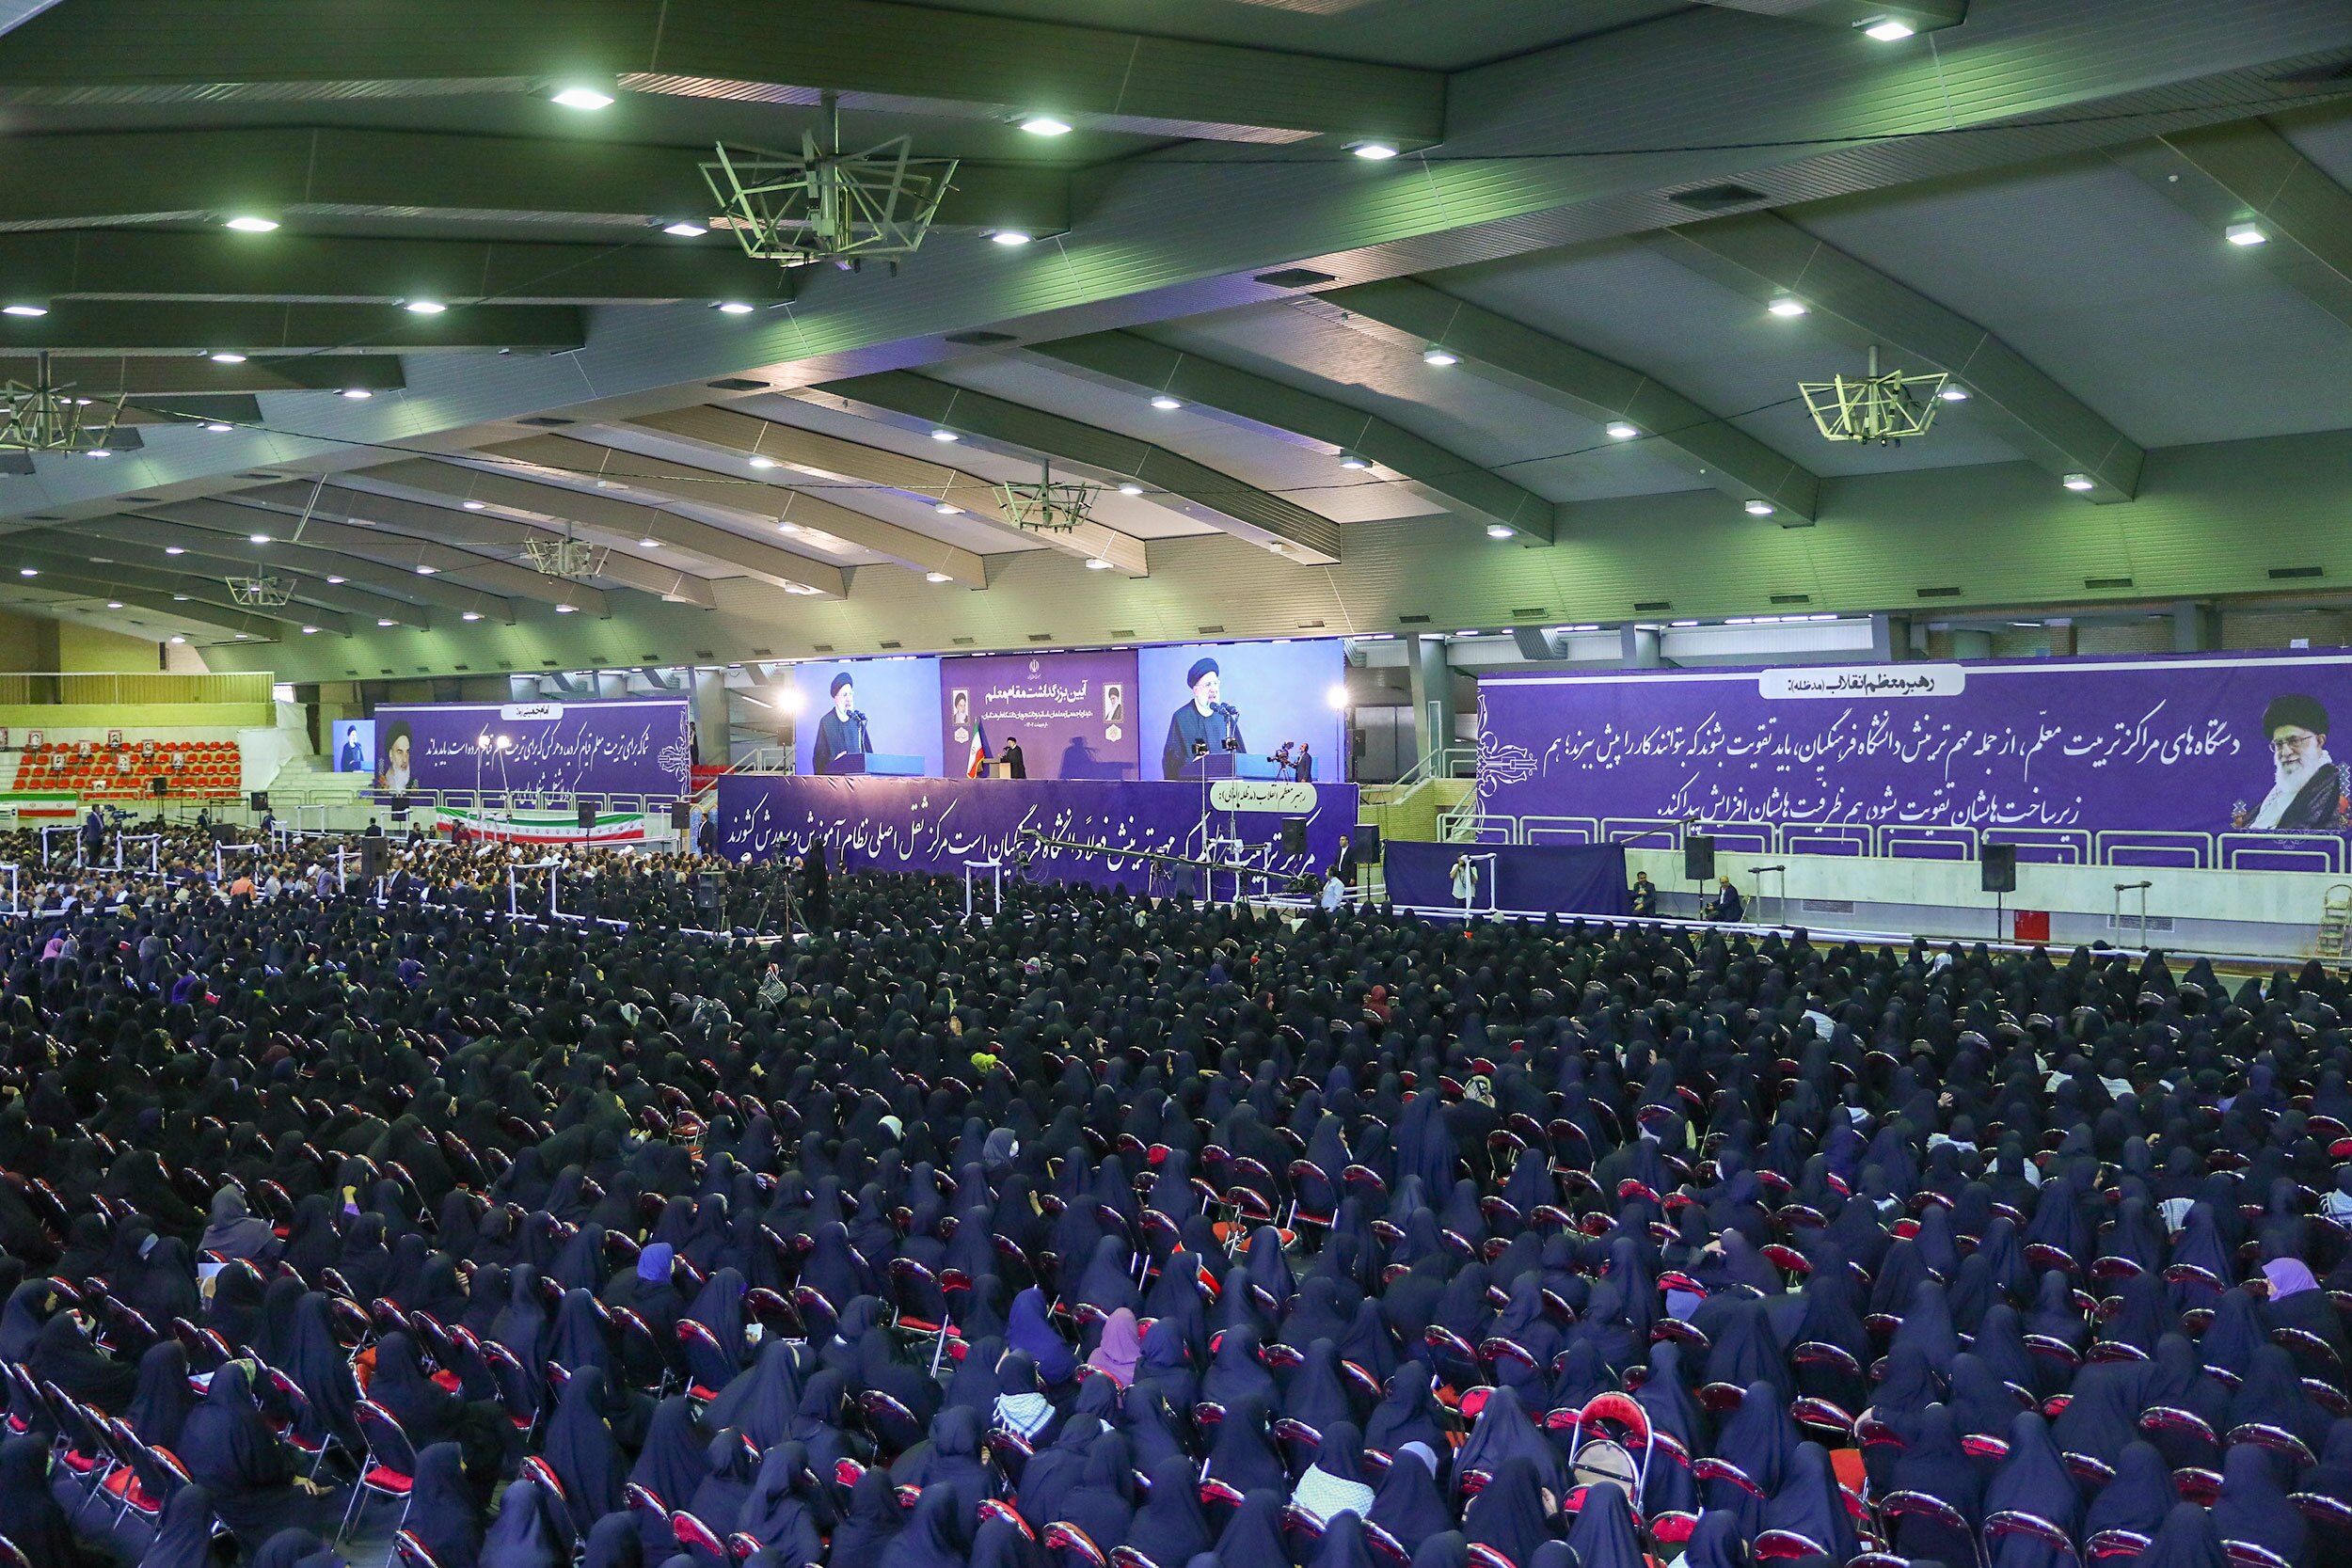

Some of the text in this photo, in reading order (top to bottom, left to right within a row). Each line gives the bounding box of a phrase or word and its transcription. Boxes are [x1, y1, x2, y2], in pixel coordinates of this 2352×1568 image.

[985, 679, 1089, 705] آیین بزرگداشت مقام معلم
[1826, 673, 1866, 695] انقلاب
[1866, 673, 1906, 697] معظم
[1902, 674, 1935, 695] رهبر
[537, 725, 551, 756] که
[603, 734, 625, 764] تربیت
[1596, 722, 1621, 769] پیش
[1624, 730, 1635, 756] را
[1633, 725, 1661, 756] کار
[1650, 726, 1686, 768] بتوانند
[1685, 710, 1717, 756] که
[1695, 721, 1725, 768] بشوند
[1725, 717, 1777, 769] تقویت
[1857, 709, 1900, 755] دانشگاه
[1997, 727, 2016, 755] از
[2063, 721, 2124, 768] تربیت
[2121, 699, 2167, 764] مراکز
[523, 737, 538, 766] برای
[578, 732, 593, 771] قیام
[590, 736, 604, 772] معلم
[623, 737, 638, 767] برای
[1543, 737, 1562, 779] هم
[1771, 734, 1791, 771] باید
[1972, 731, 1998, 775] جمله
[1256, 784, 1278, 804] انقلاب
[1277, 783, 1294, 811] معظم
[1290, 791, 1306, 809] رهبر
[1683, 791, 1703, 835] پیدا
[1701, 784, 1748, 829] افزایش
[1899, 782, 1956, 836] تقویت
[726, 792, 770, 844] کشورند
[898, 795, 930, 862] ثقل
[926, 798, 958, 863] مرکز
[1041, 807, 1084, 862] دانشگاه
[1842, 800, 1864, 846] هم
[790, 831, 798, 847] و
[841, 817, 869, 863] نظام
[867, 821, 898, 859] اصلی
[947, 831, 987, 855] است
